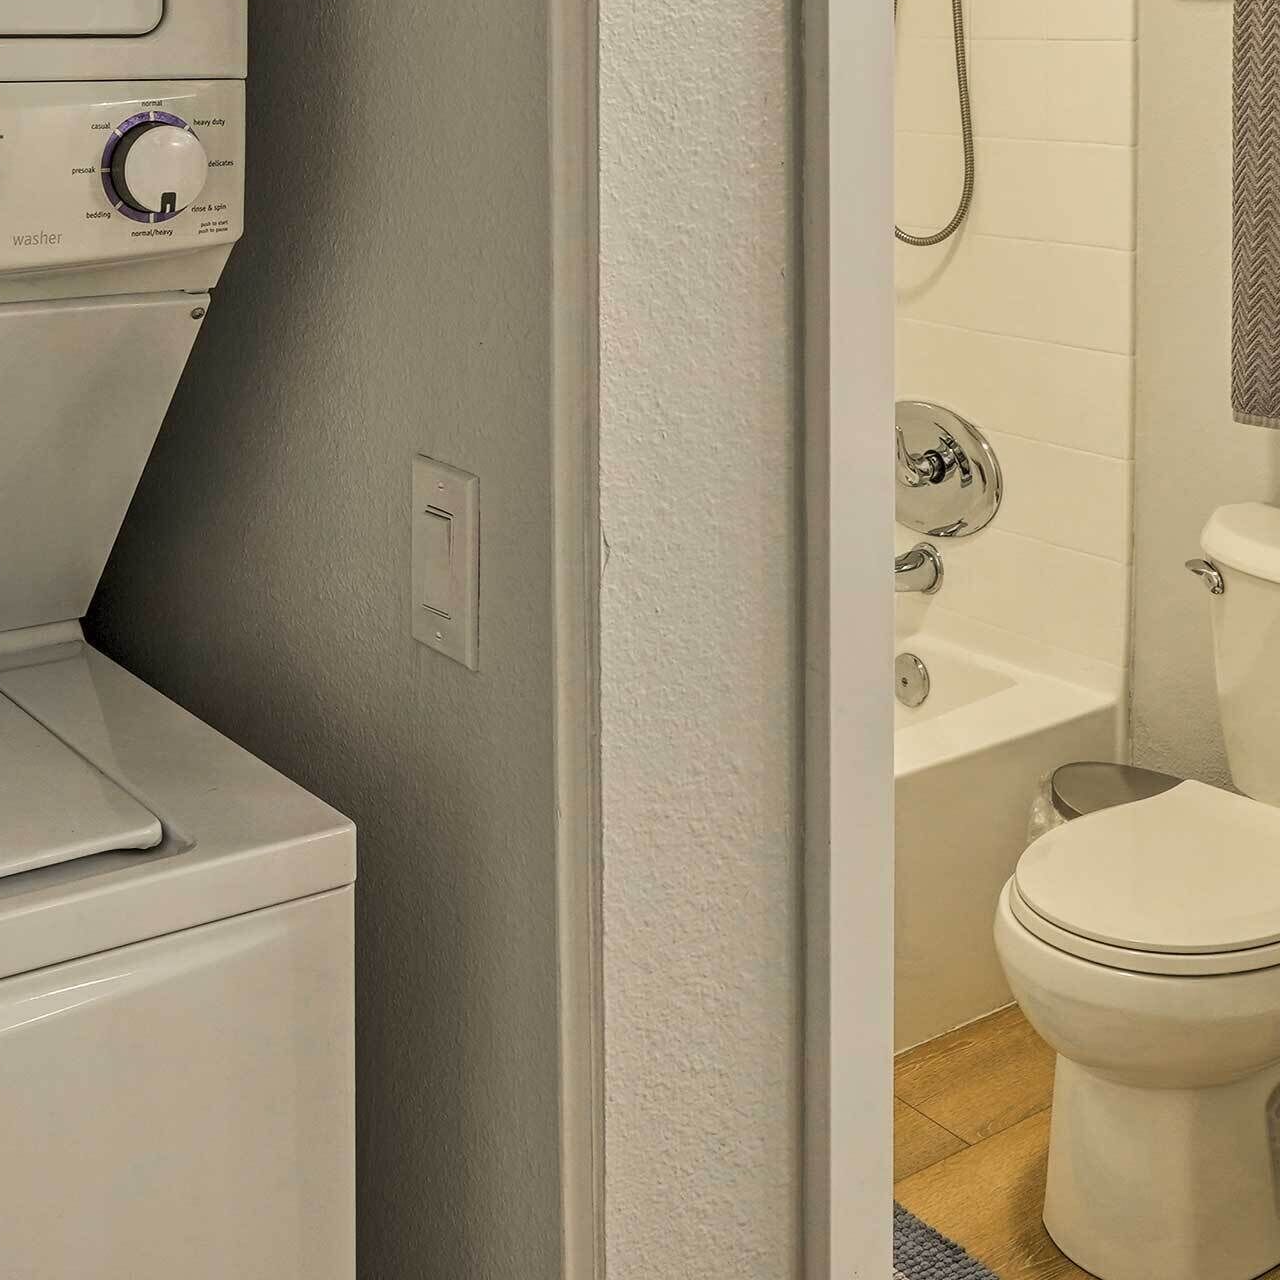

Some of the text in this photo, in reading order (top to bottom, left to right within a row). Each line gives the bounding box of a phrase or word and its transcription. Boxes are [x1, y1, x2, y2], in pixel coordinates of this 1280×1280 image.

[91, 122, 111, 130] casual
[72, 166, 96, 176] presoak
[86, 211, 111, 220] bedding
[131, 229, 173, 237] normal/heavy
[12, 230, 63, 247] washer
